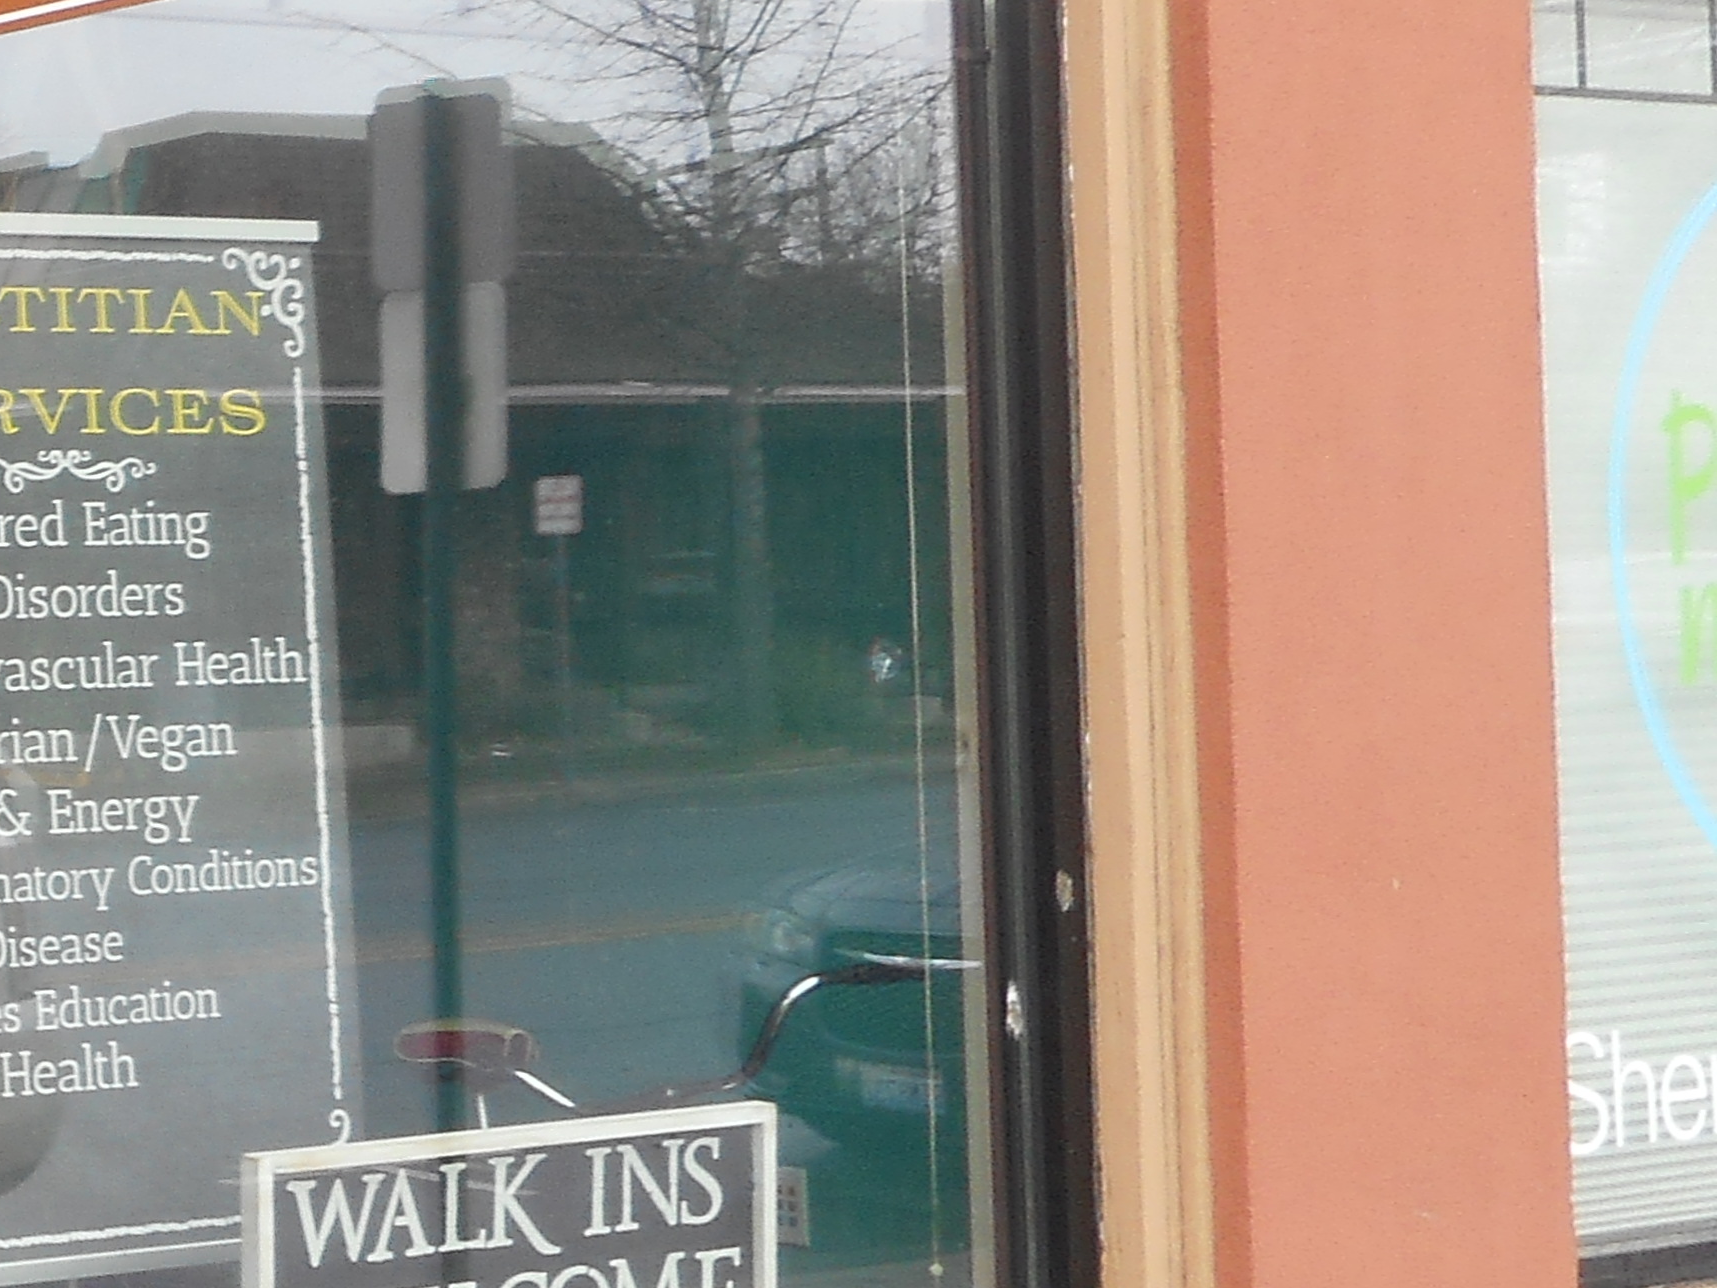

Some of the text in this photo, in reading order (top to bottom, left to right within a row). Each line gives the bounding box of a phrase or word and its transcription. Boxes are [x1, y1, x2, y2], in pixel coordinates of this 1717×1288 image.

[82, 500, 211, 560] Eating
[173, 636, 308, 686] Health
[48, 788, 200, 844] Energy
[128, 848, 319, 896] Conditions
[34, 980, 221, 1032] Education
[0, 1040, 139, 1098] Health
[285, 1136, 724, 1268] WALK INS
